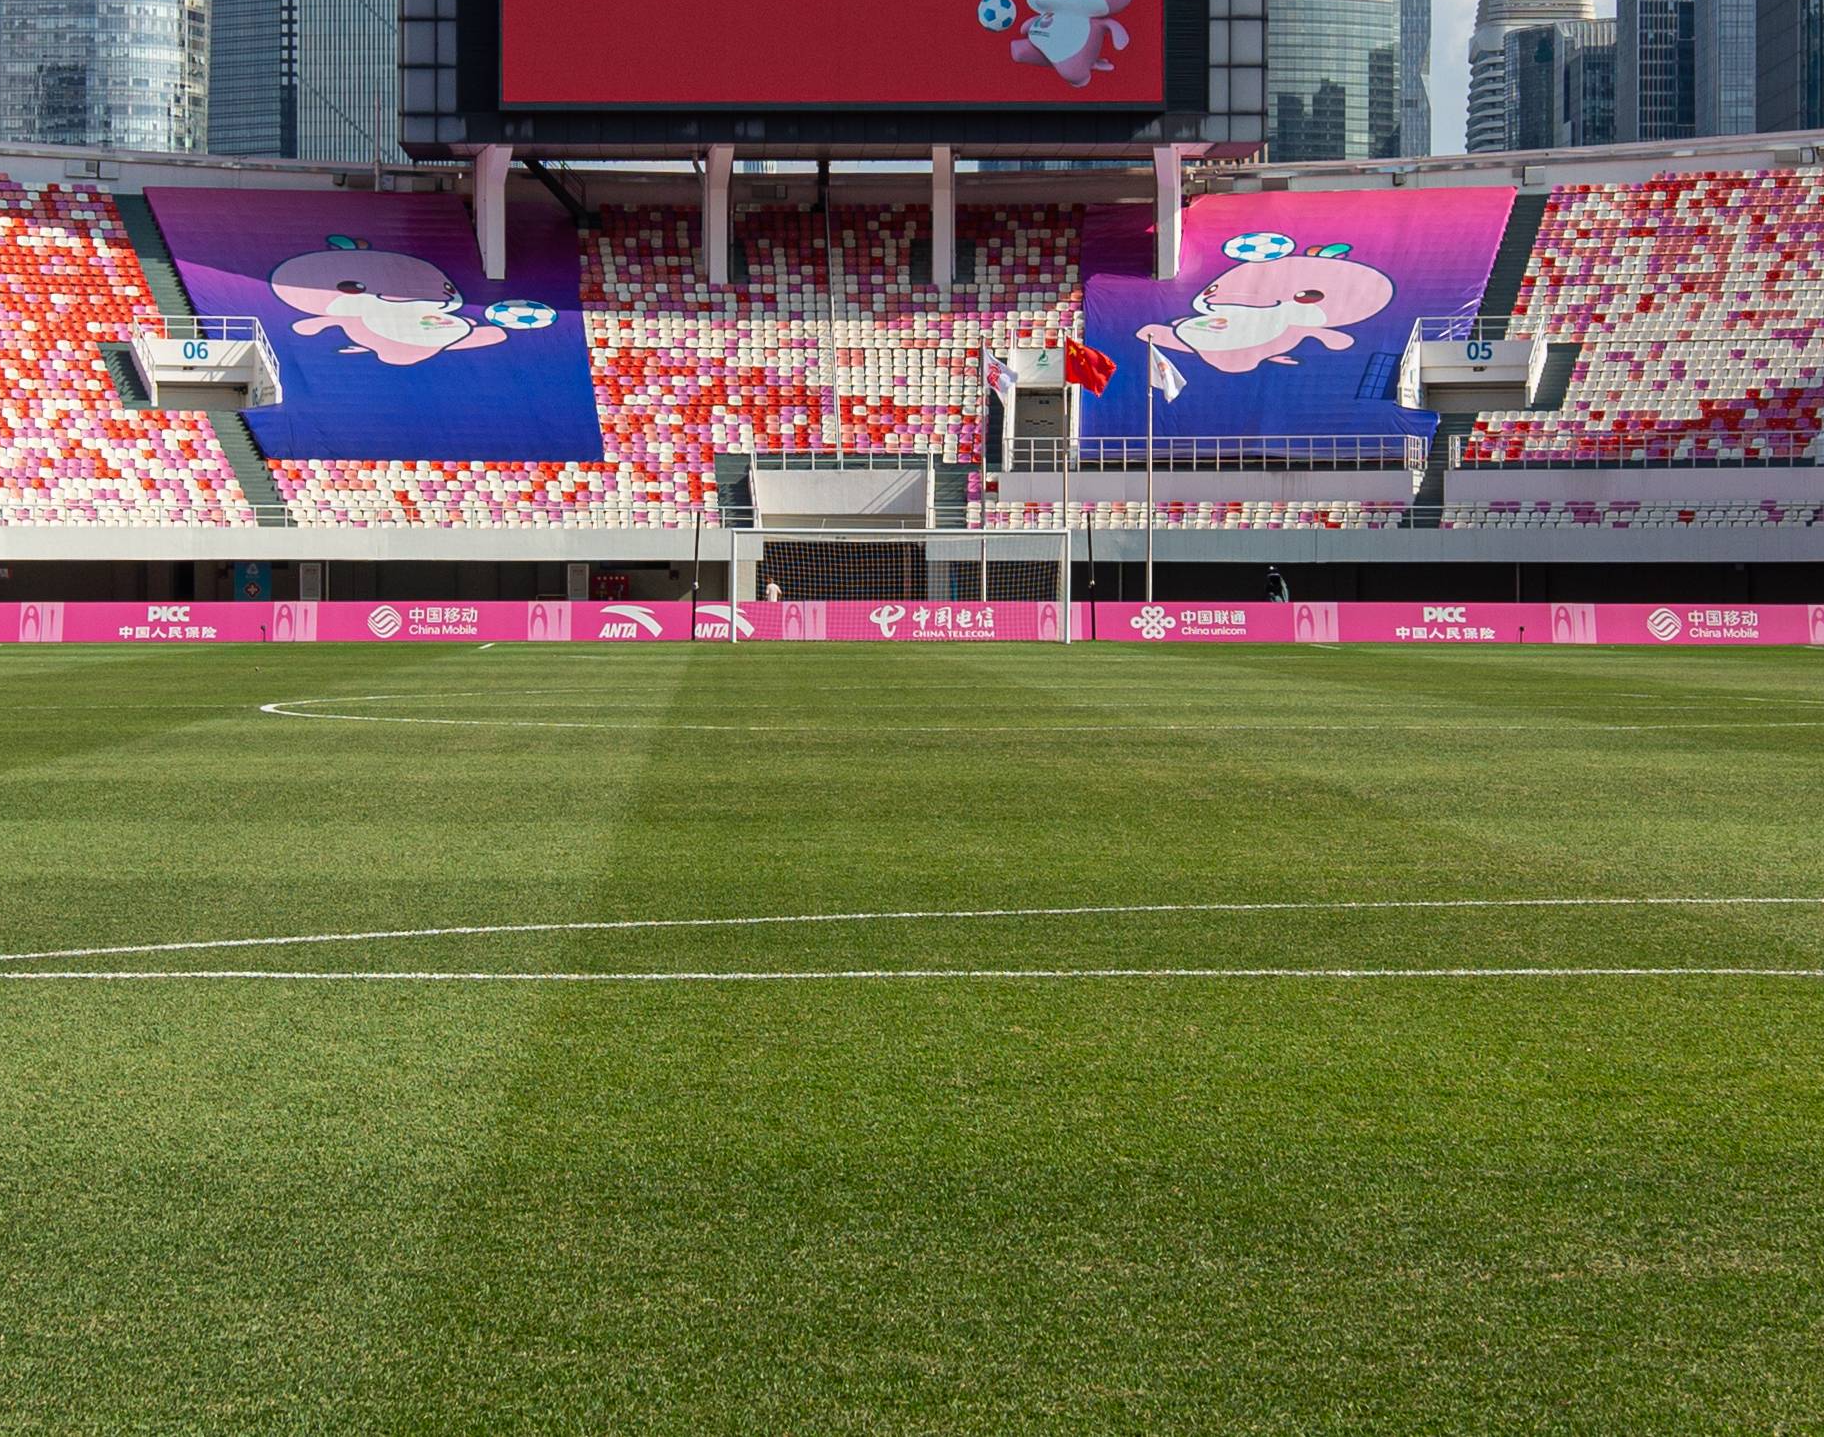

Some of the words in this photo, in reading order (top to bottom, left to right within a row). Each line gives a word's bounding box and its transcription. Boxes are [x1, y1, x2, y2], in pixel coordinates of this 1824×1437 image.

[183, 341, 208, 360] 06
[1467, 342, 1492, 360] 05
[147, 606, 190, 622] PICC
[409, 607, 478, 624] 中国移动
[912, 607, 995, 629] 中国电信
[1181, 610, 1246, 625] 中国联通
[1423, 607, 1466, 623] PICC
[1688, 610, 1758, 627] 中国移动
[119, 626, 217, 639] 中国人民保险
[409, 624, 440, 635] China
[442, 624, 478, 635] Mobile
[599, 623, 637, 638] ANTA
[694, 623, 729, 638] ANTA
[913, 630, 945, 638] CHINA
[947, 630, 995, 638] TELECOM
[1181, 626, 1209, 636] China
[1210, 626, 1246, 636] unicom
[1395, 627, 1495, 640] 中国人民保险
[1689, 628, 1721, 639] China
[1723, 628, 1759, 639] Mobile
